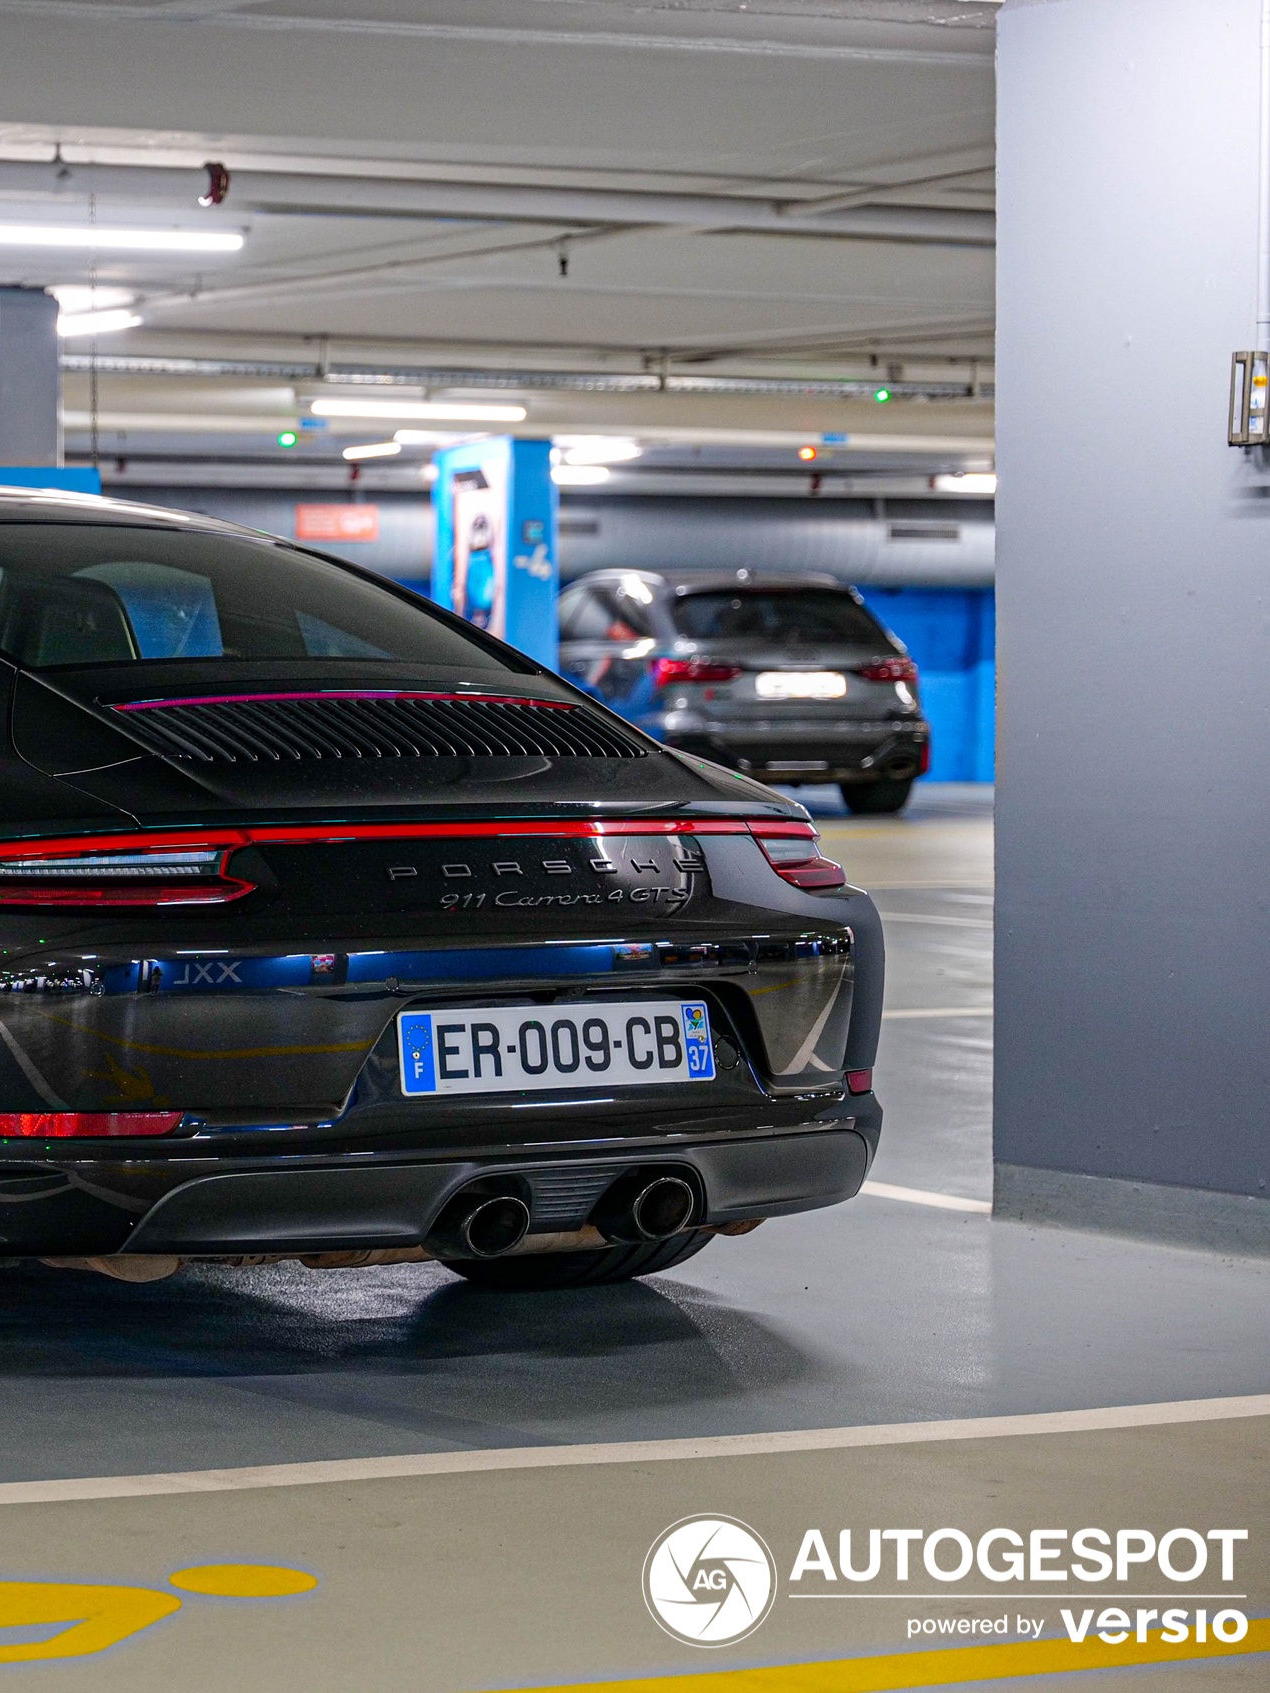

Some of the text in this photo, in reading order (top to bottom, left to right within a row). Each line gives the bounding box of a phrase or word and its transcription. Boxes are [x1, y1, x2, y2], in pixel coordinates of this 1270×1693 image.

[385, 857, 705, 880] PORSCHE
[439, 887, 690, 910] 911 Carrera 4 GTS
[436, 1015, 683, 1080] ER-009-CB
[688, 1045, 709, 1071] 37
[414, 1062, 424, 1079] F
